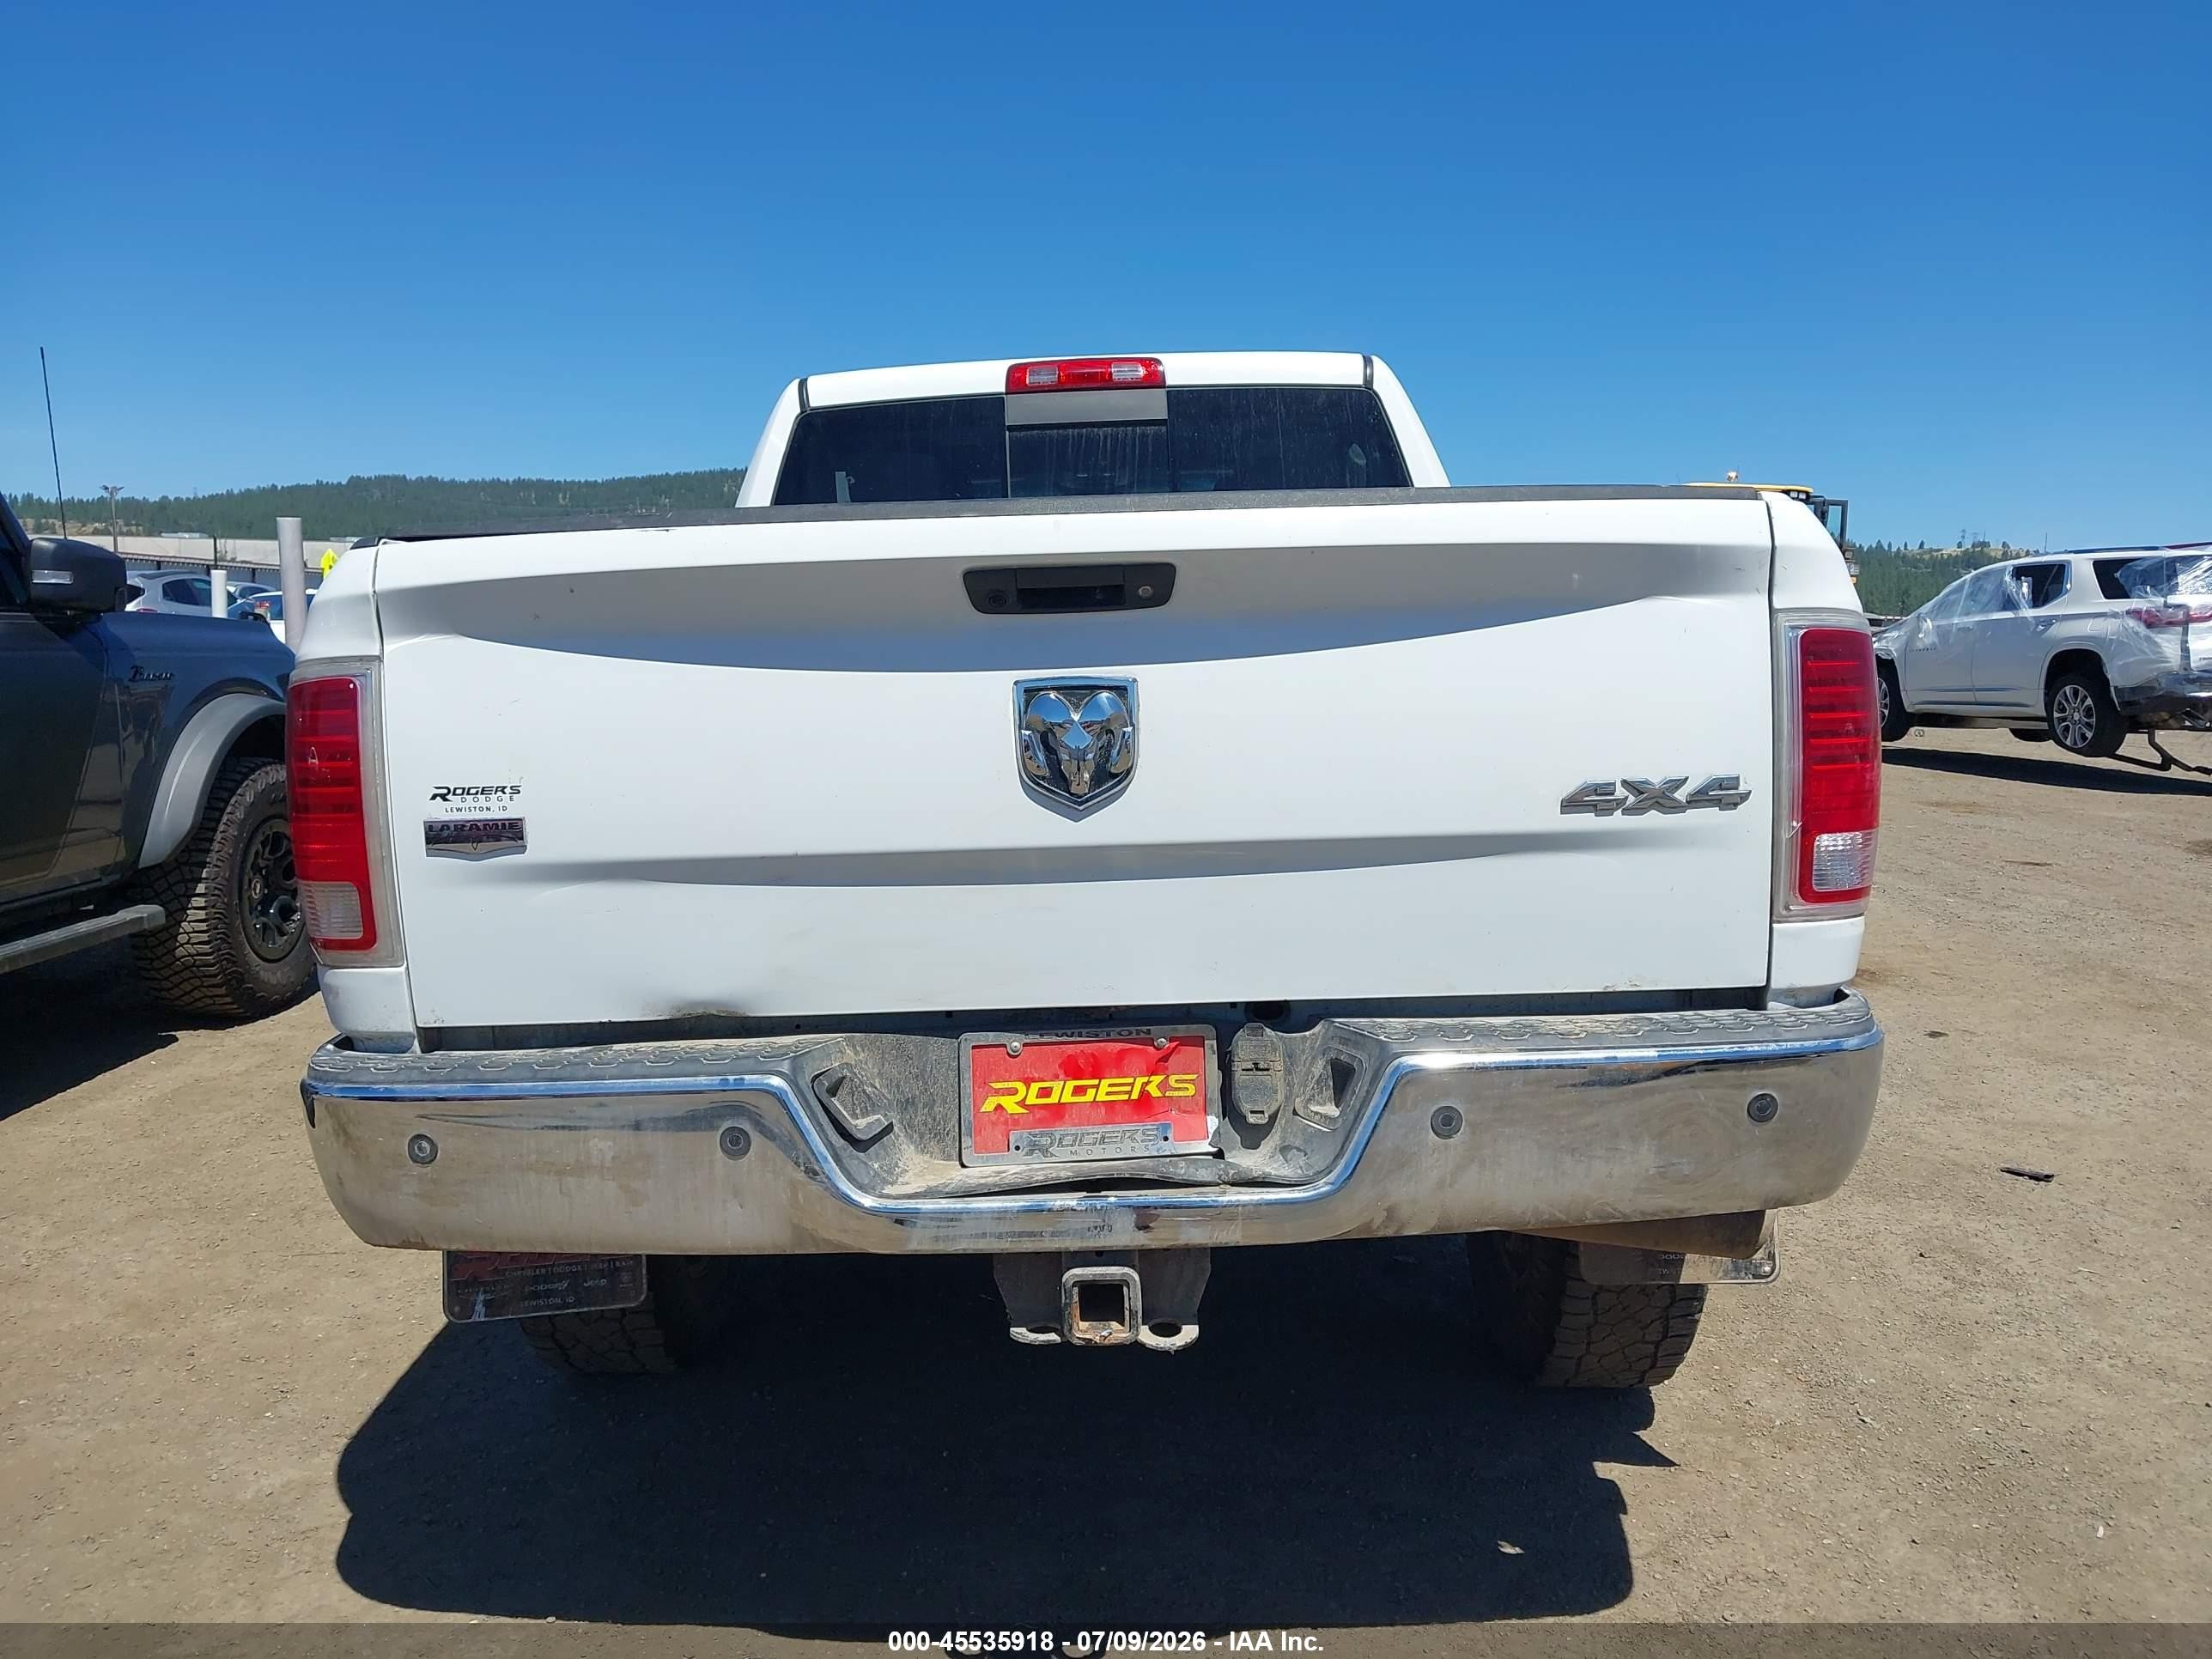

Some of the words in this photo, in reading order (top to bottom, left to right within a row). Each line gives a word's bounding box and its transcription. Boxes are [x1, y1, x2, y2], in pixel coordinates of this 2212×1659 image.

[429, 785, 522, 802] ROGERS
[1560, 774, 1752, 817] 4X4
[428, 822, 523, 833] LARAMIE
[980, 1074, 1198, 1114] ROGERS
[1022, 1127, 1160, 1158] ROGERS
[1070, 1146, 1149, 1156] MOTORS
